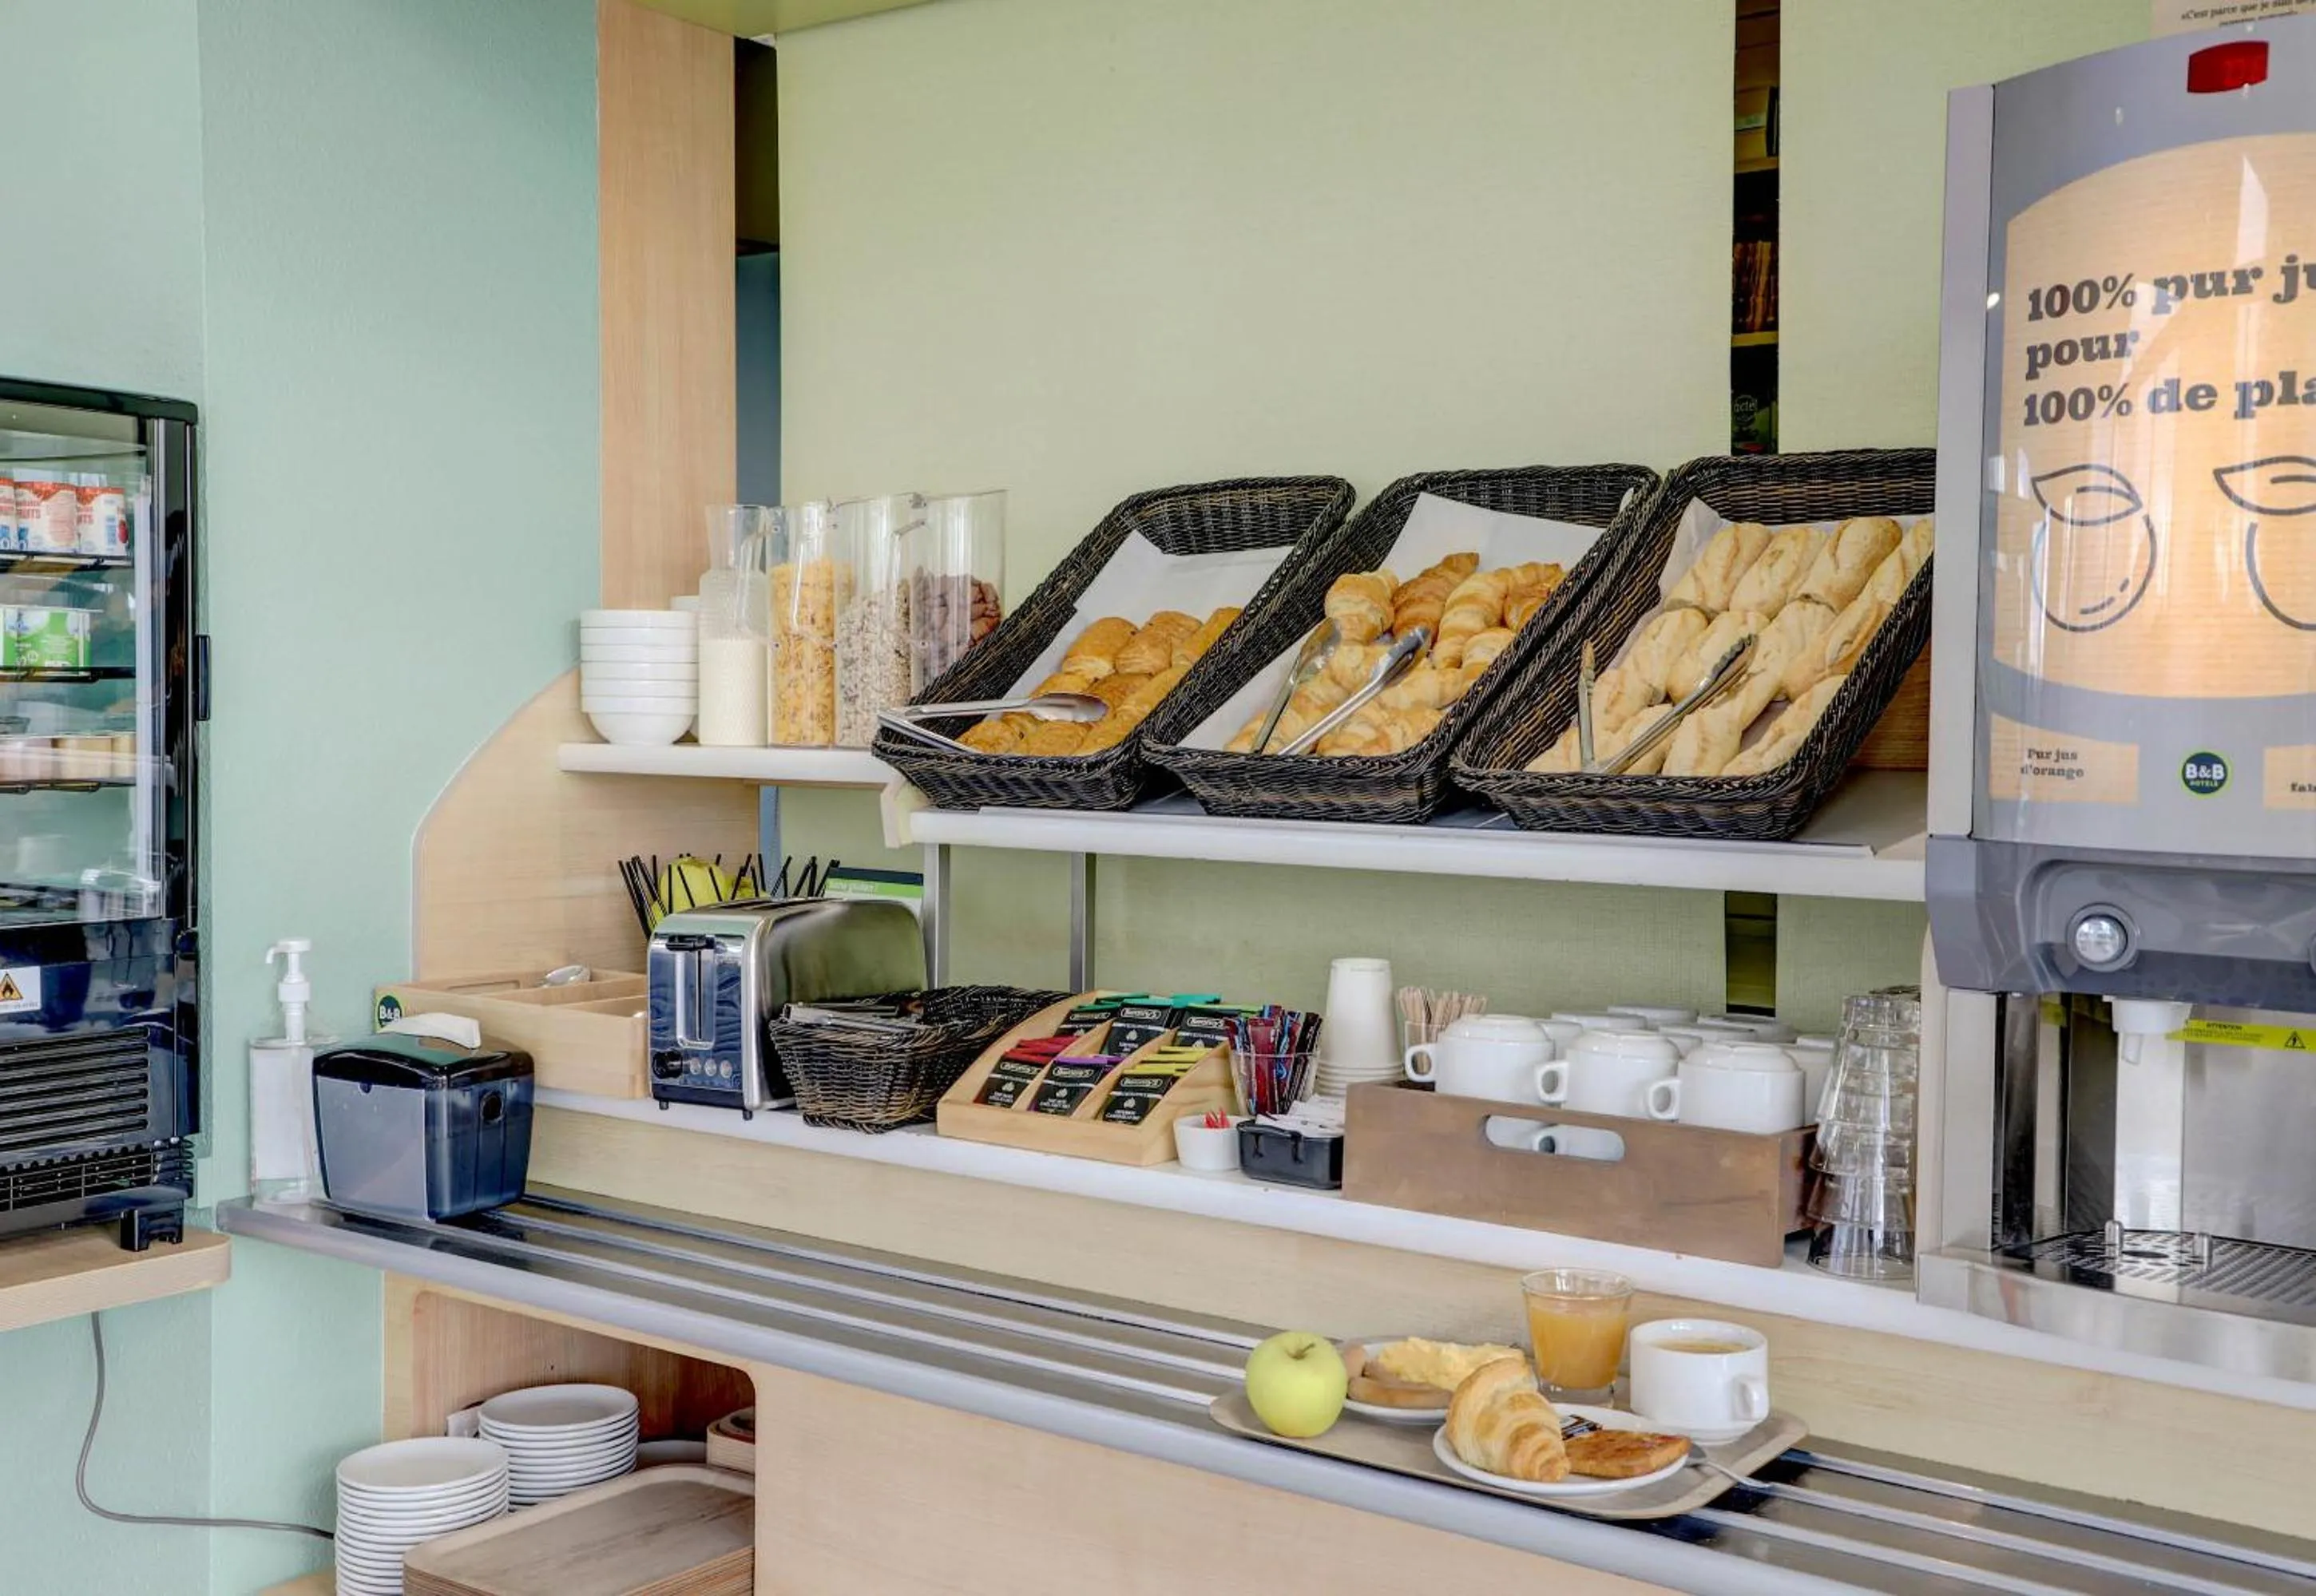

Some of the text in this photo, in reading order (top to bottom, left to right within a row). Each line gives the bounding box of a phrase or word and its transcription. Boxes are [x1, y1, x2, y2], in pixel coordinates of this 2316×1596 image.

[2028, 273, 2137, 321] 100%
[2151, 267, 2263, 315] pur
[2025, 330, 2140, 381] pour
[2024, 382, 2132, 426] 100%
[2147, 377, 2218, 414] de
[2027, 748, 2078, 762] Pur jus
[2020, 764, 2084, 780] d'orange
[2185, 763, 2225, 781] B&B
[379, 1005, 400, 1022] B&B
